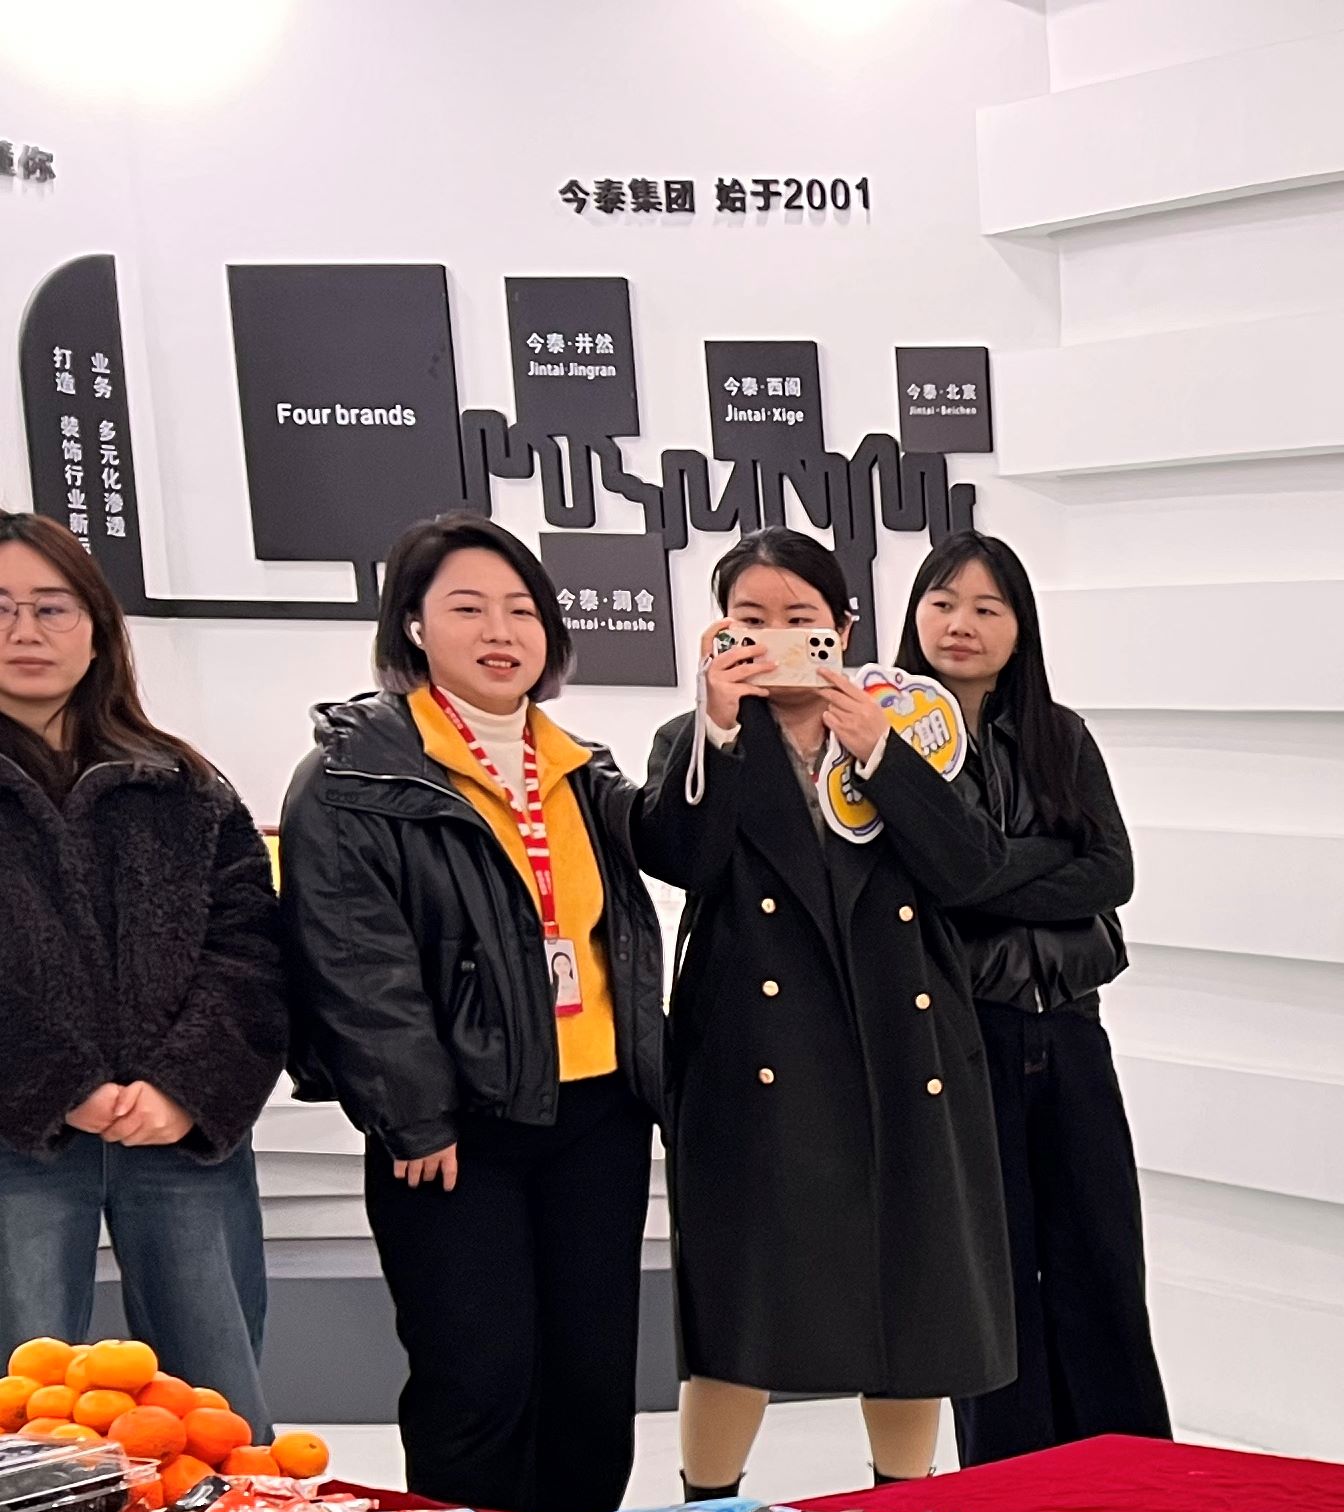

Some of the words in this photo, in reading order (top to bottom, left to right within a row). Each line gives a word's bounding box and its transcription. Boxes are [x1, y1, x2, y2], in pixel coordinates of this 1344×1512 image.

[559, 178, 695, 214] 今泰集团
[714, 177, 870, 214] 始于2001
[53, 346, 76, 395] 打造
[91, 353, 112, 399] 业务
[277, 402, 332, 426] Four
[335, 403, 416, 426] brands
[99, 420, 126, 538] 多元化渗透
